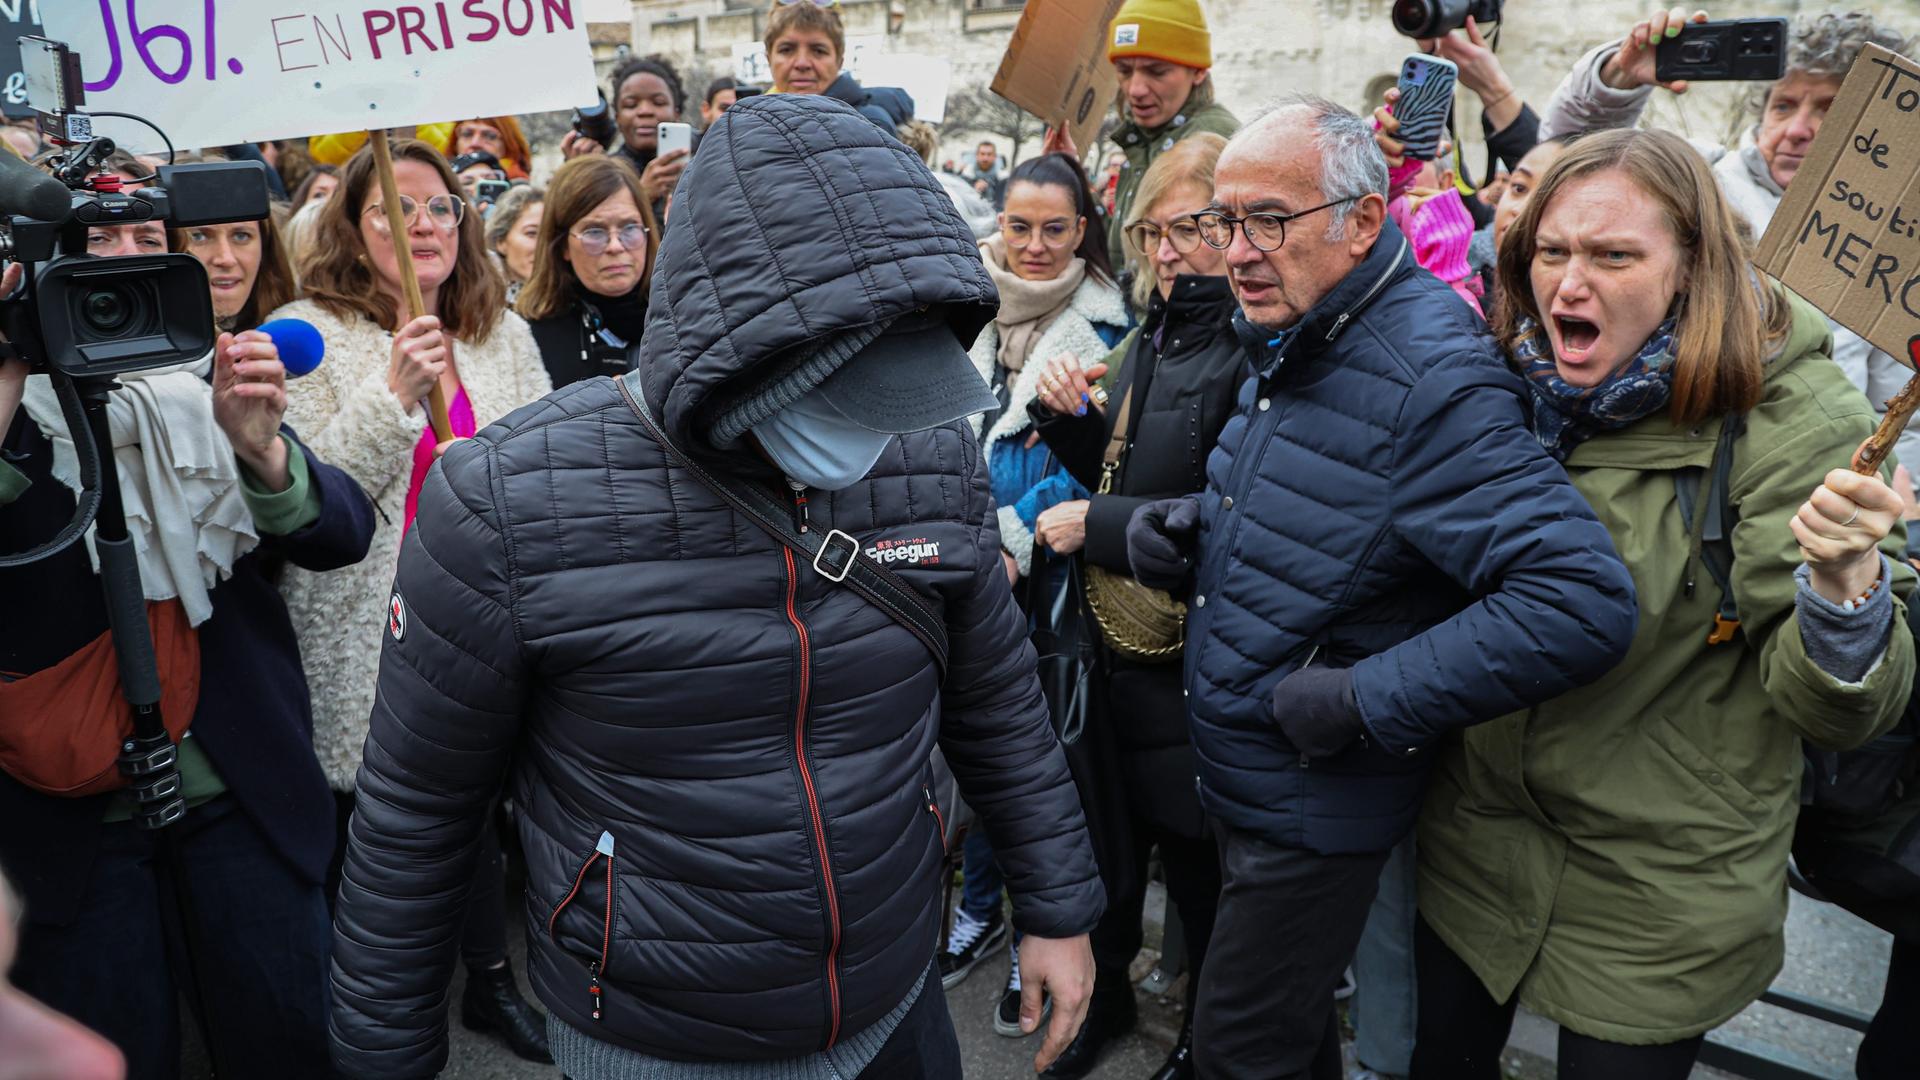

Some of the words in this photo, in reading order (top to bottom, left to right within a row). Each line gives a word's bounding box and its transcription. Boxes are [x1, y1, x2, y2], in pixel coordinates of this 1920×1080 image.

[271, 14, 352, 72] EN
[363, 0, 575, 60] PRISON
[1854, 128, 1889, 169] de
[1829, 179, 1920, 239] souti
